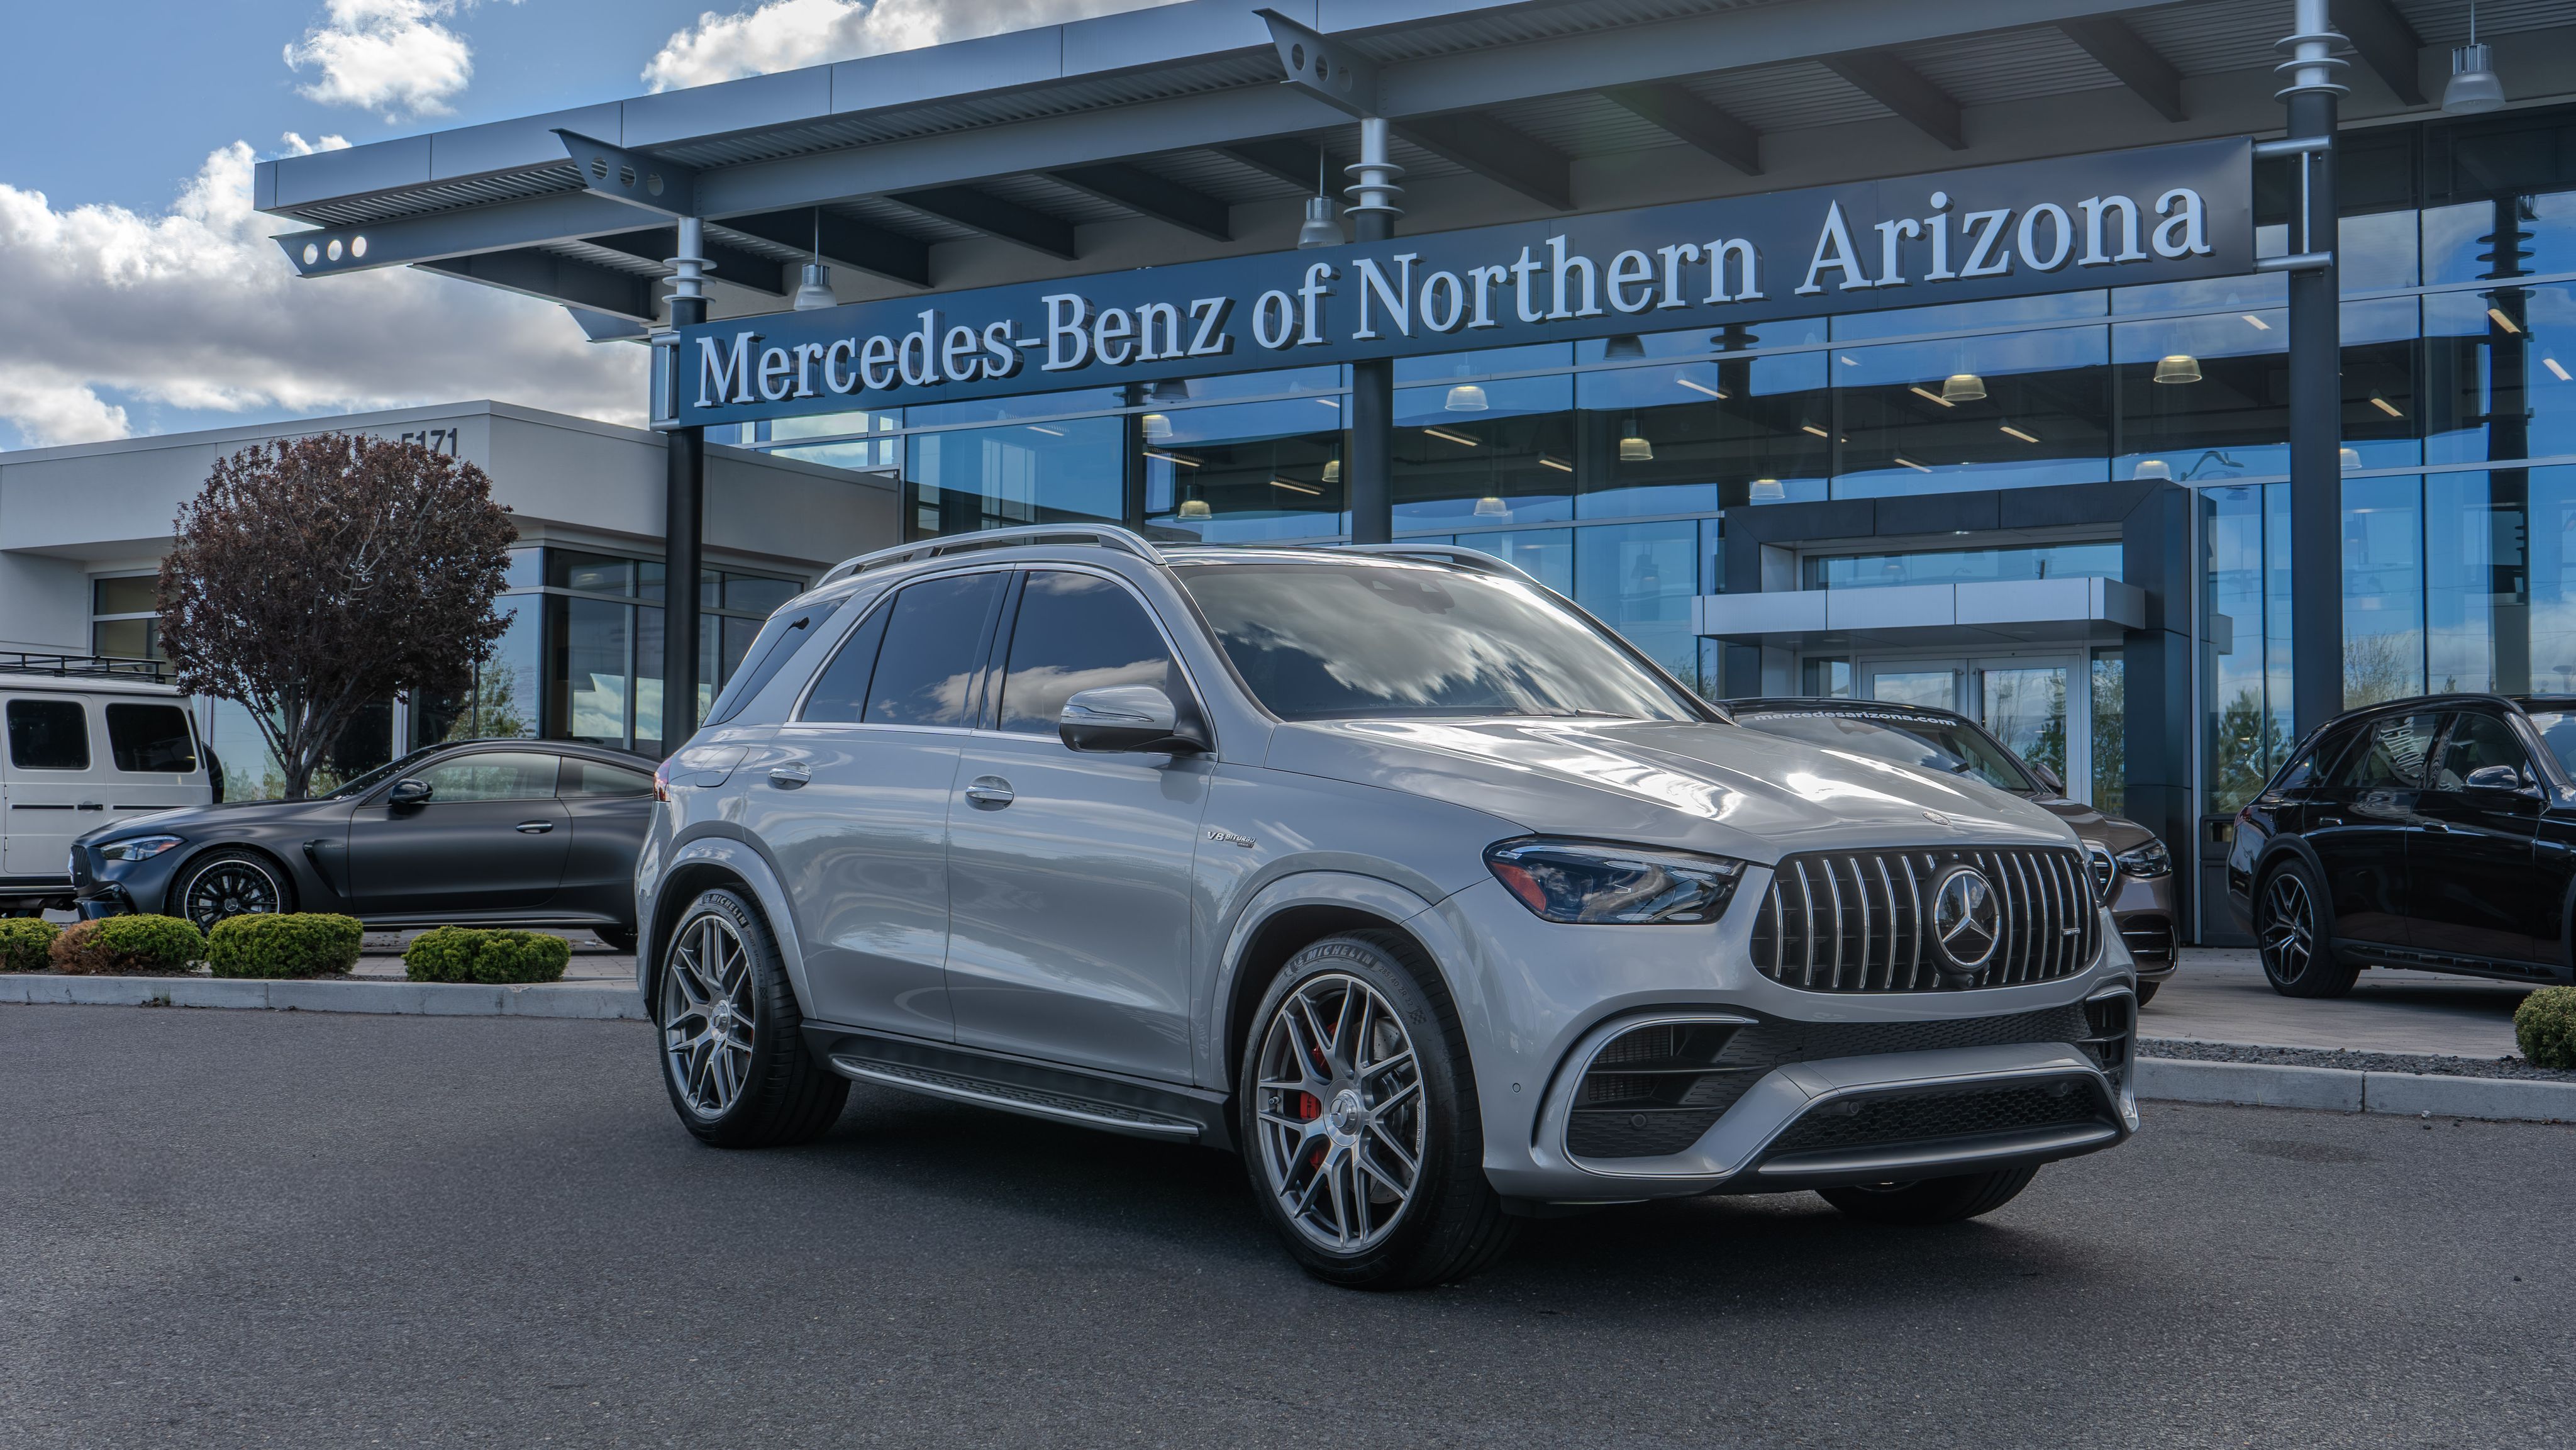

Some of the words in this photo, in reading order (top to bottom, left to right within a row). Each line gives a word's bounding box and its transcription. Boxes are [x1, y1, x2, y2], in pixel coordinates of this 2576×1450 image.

[694, 293, 1233, 408] Mercedes-Benz
[1252, 262, 1335, 349] of
[1352, 233, 1765, 341] Northern
[1794, 187, 2212, 296] Arizona
[1754, 711, 1957, 726] mercedesarizona.com
[1208, 831, 1226, 841] V8
[1226, 834, 1256, 843] BITURBO
[711, 895, 747, 925] MICHELIN
[747, 930, 755, 947] PILOT
[754, 949, 763, 971] SPORT
[1306, 945, 1375, 965] MICHELIN
[1379, 966, 1399, 986] 285/40
[1406, 998, 1414, 1007] 22
